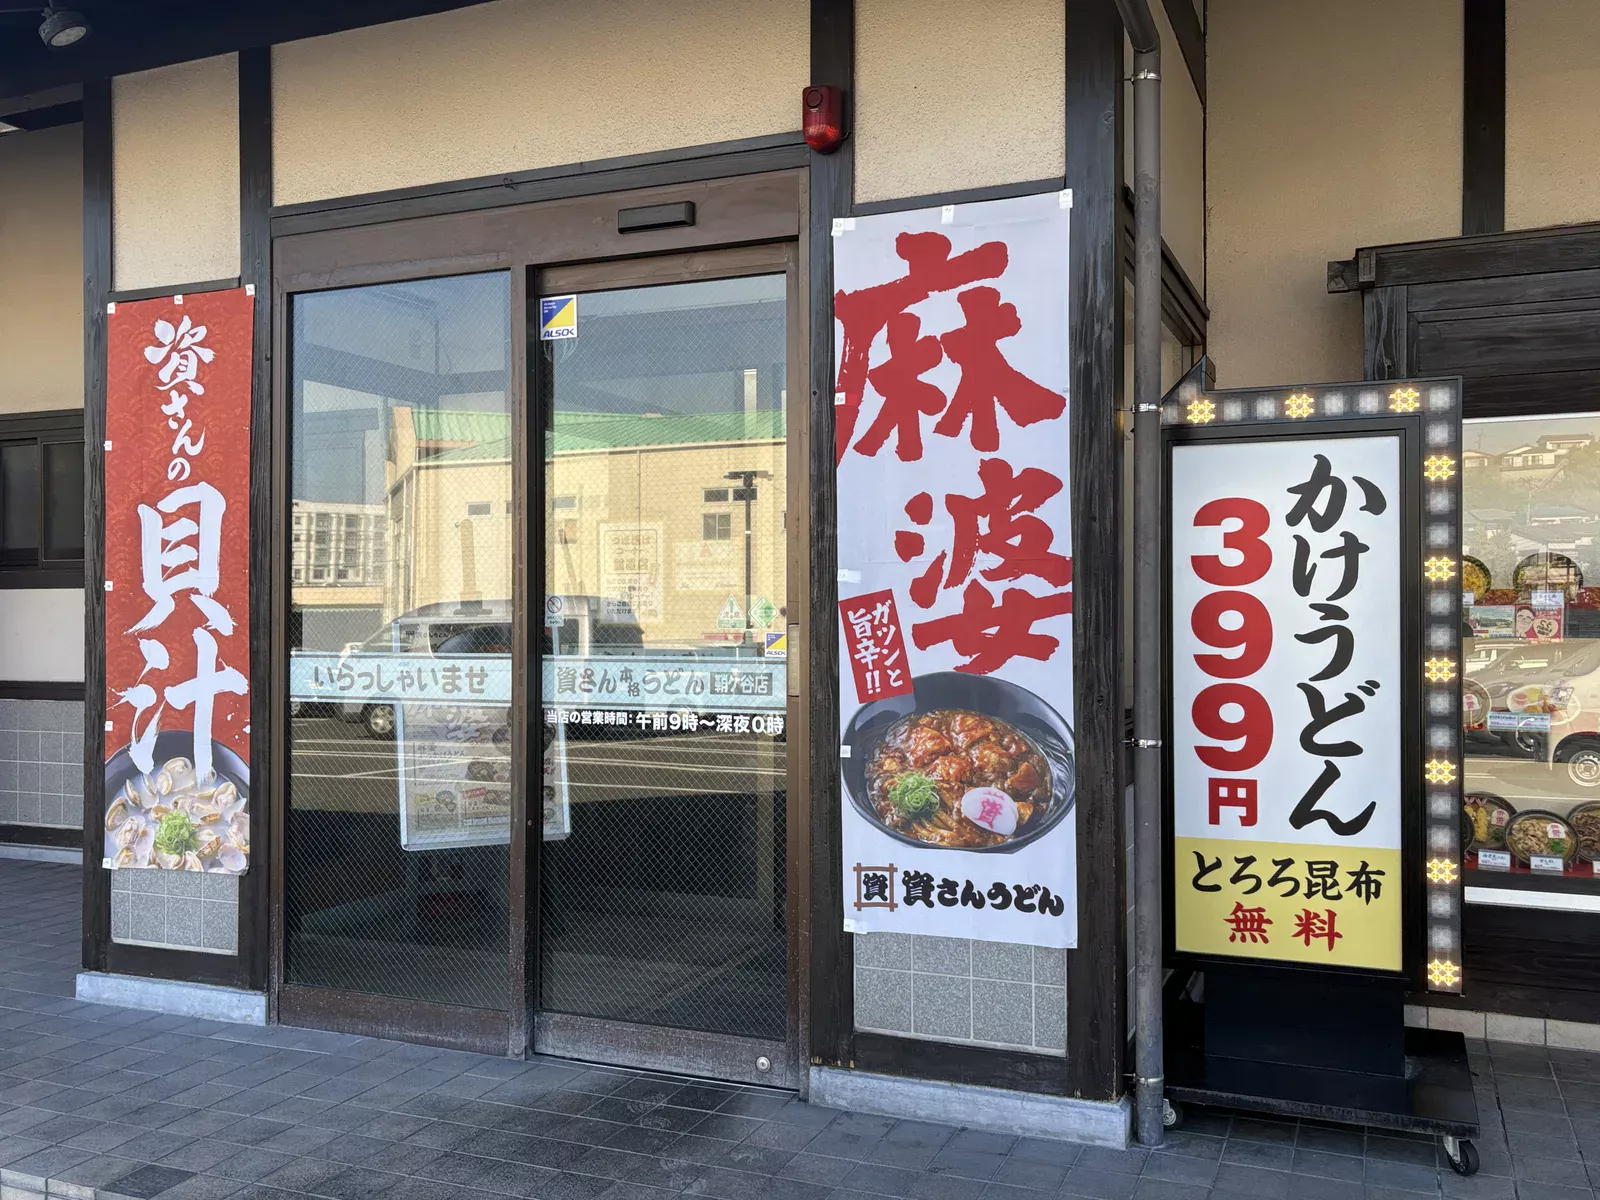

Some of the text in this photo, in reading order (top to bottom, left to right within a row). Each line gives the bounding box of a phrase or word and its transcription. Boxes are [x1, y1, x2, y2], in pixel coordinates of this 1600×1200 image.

[543, 328, 575, 338] ALSOK
[144, 315, 216, 481] 資さんの
[835, 232, 1073, 674] 麻婆
[112, 481, 249, 785] 貝汁
[847, 608, 881, 695] 旨辛!!
[871, 599, 903, 687] ガツンと
[1190, 497, 1274, 827] 399円
[1286, 454, 1387, 836] かけうどん
[313, 662, 489, 694] いらっしゃいませ
[863, 873, 889, 901] 資
[902, 870, 1065, 917] 資さんうどん
[1192, 850, 1385, 906] とろろ昆布
[1223, 901, 1343, 951] 無料
